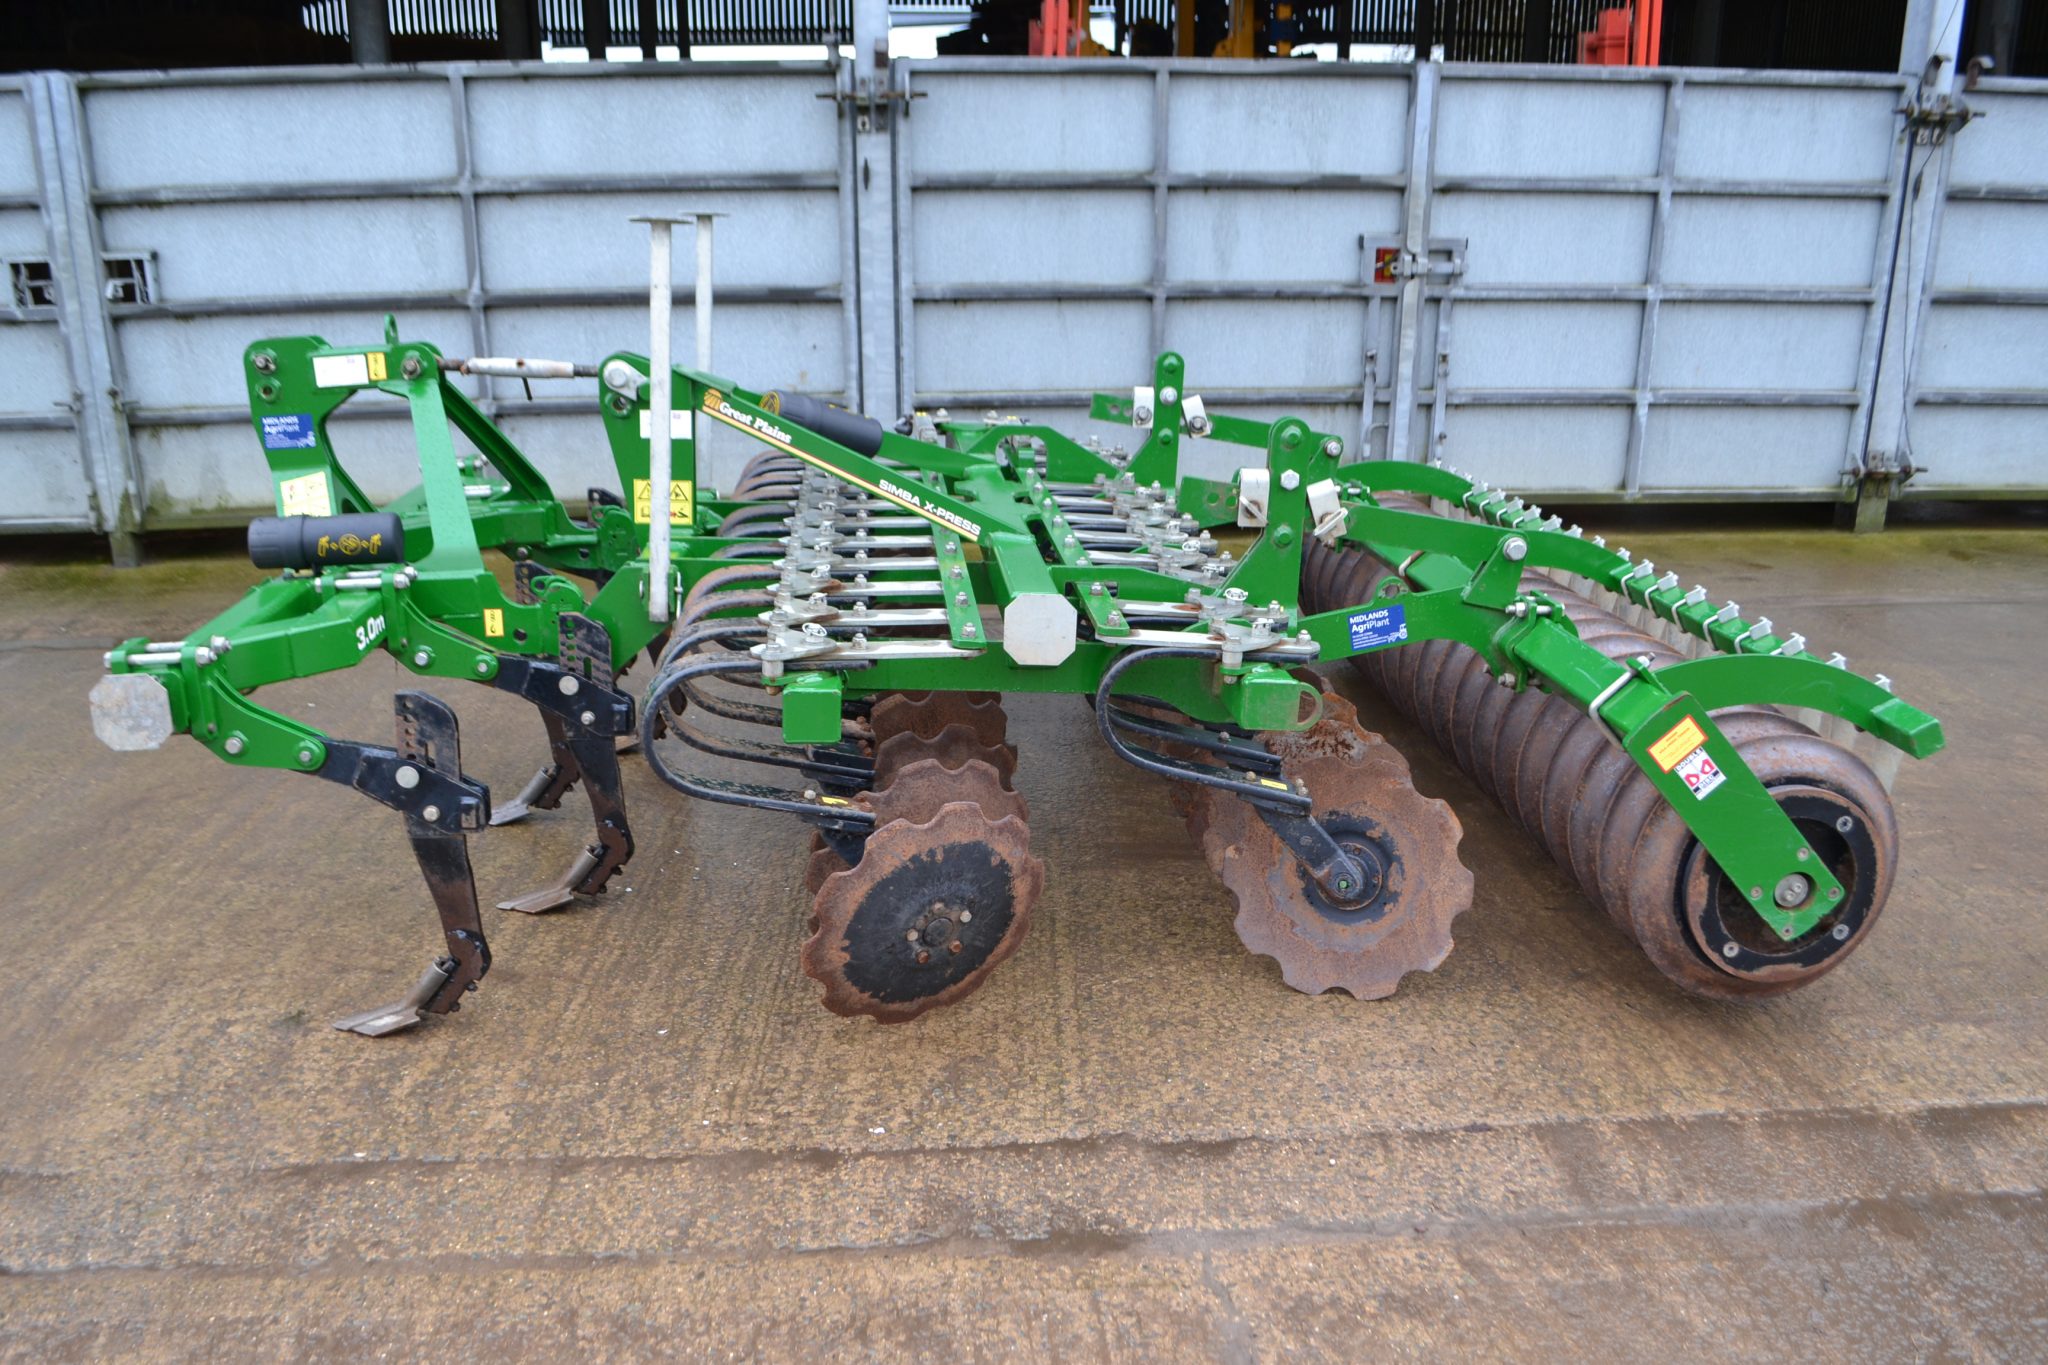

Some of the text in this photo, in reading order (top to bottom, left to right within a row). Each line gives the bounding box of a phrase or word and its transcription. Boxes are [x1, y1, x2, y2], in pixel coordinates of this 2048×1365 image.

[720, 402, 792, 444] Great Plains
[879, 479, 982, 535] SIMBA X-PRESS
[356, 615, 385, 650] 3.0m
[1350, 609, 1389, 624] MIDLANDS
[1352, 618, 1390, 633] AgriPlant
